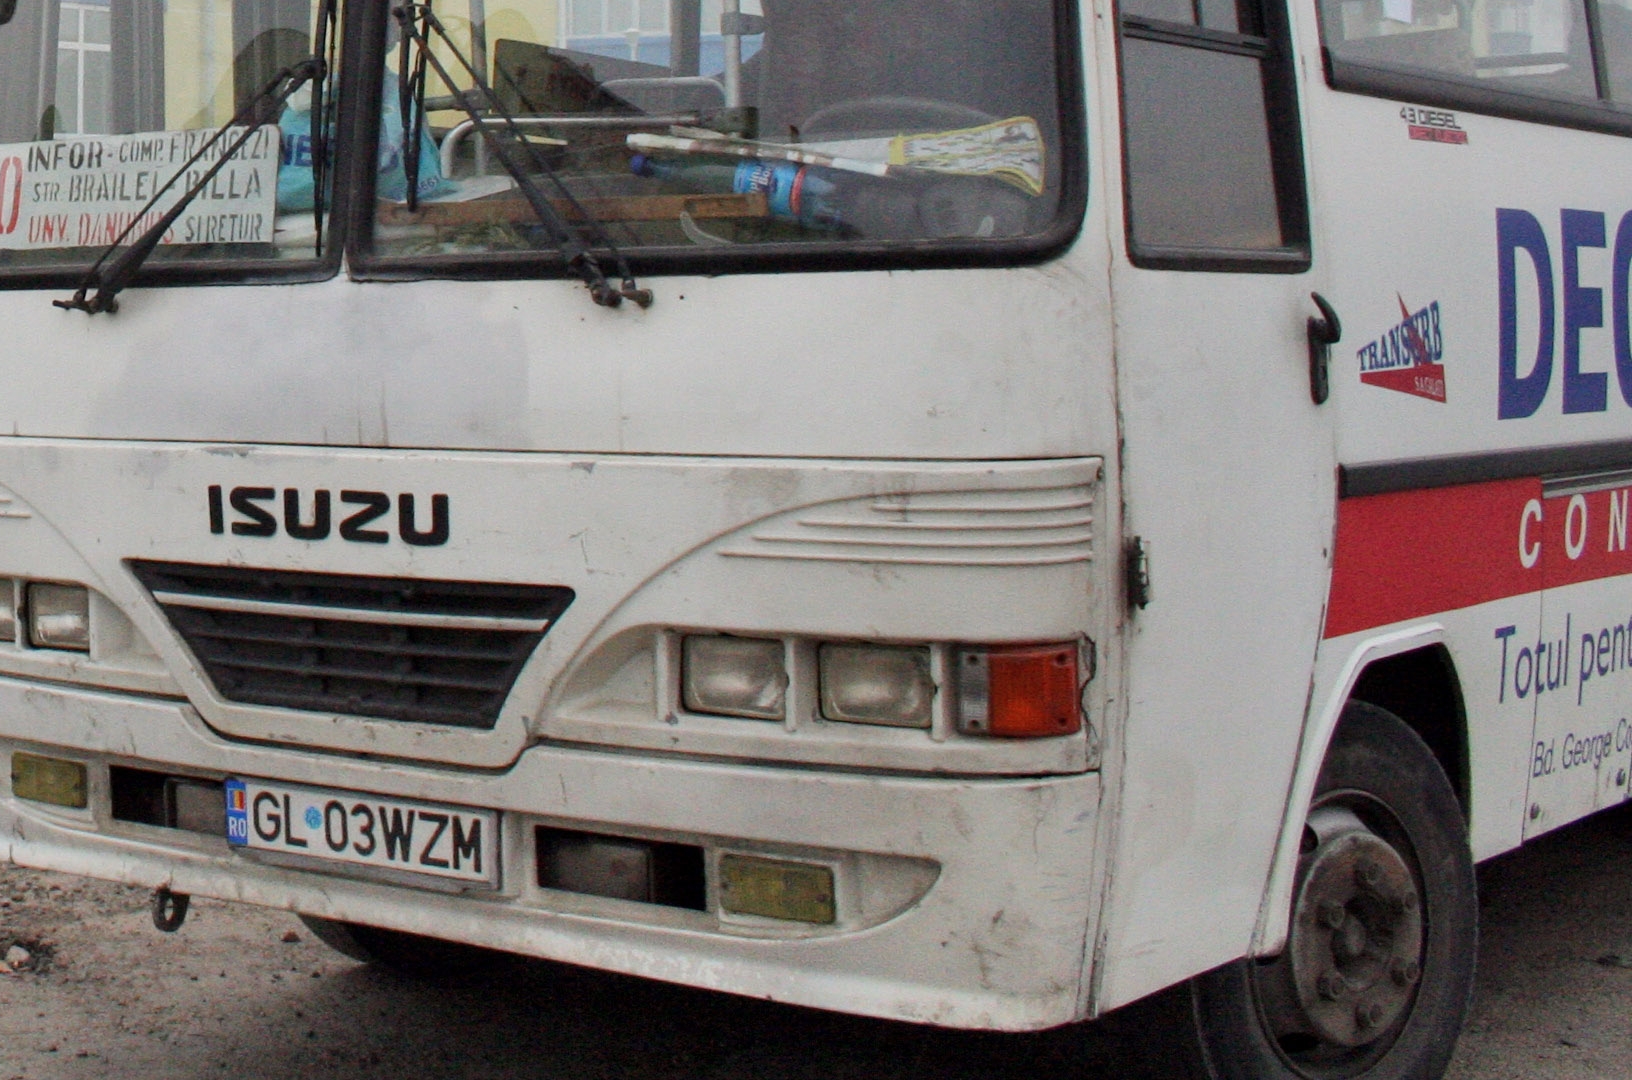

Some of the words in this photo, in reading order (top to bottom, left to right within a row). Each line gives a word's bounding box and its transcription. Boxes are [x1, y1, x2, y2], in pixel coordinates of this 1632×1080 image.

[28, 141, 103, 172] INFOR
[208, 484, 449, 546] ISUZU
[1518, 489, 1628, 569] CON
[1495, 612, 1571, 704] Totul
[1533, 738, 1556, 778] Bd.
[1562, 732, 1613, 770] George
[228, 816, 247, 838] RO
[253, 790, 308, 848] GL
[324, 800, 482, 873] 03WZM
